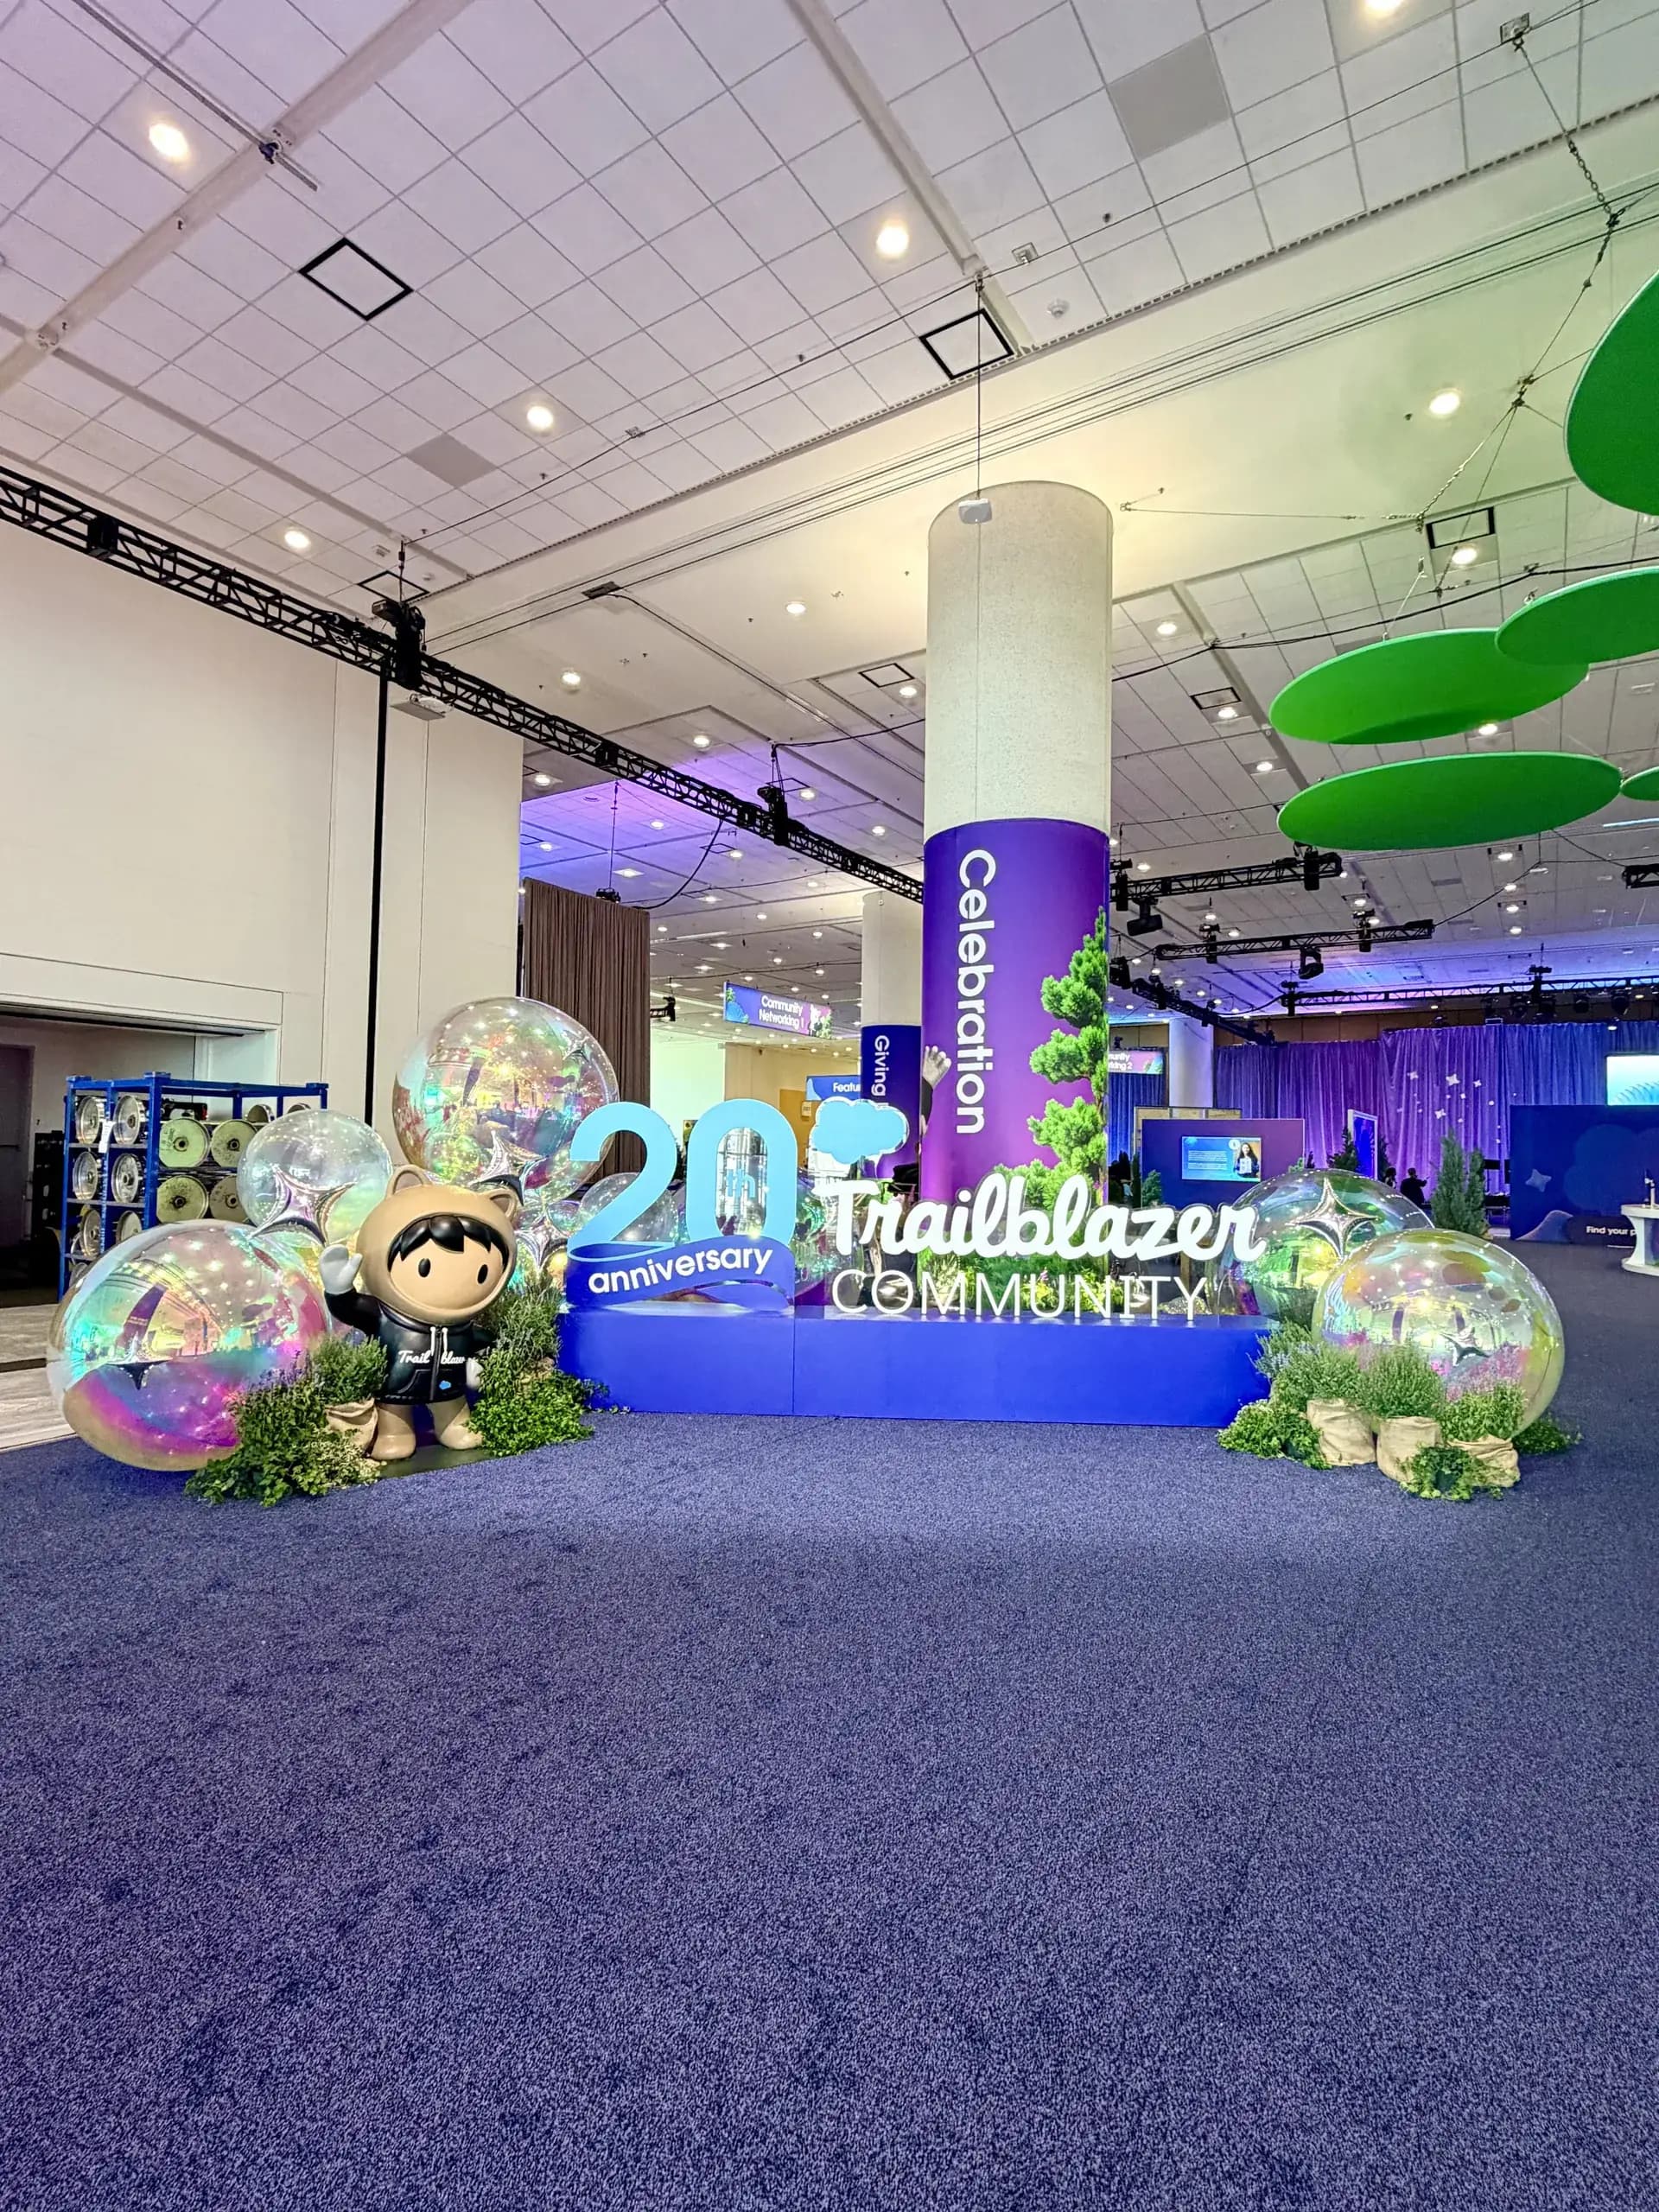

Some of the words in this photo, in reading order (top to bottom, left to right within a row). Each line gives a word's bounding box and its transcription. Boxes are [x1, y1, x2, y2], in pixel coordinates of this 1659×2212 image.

[761, 995, 804, 1017] Community
[956, 849, 997, 1135] Celebration
[759, 1008, 799, 1030] Networking
[871, 1035, 890, 1096] Giving
[567, 1098, 798, 1257] 20
[811, 1172, 1268, 1262] Trailblazer
[1586, 1225, 1606, 1235] Find
[1607, 1228, 1629, 1236] your
[588, 1248, 773, 1294] anniversary
[831, 1268, 1208, 1321] COMMUNITY
[397, 1349, 431, 1364] Trail
